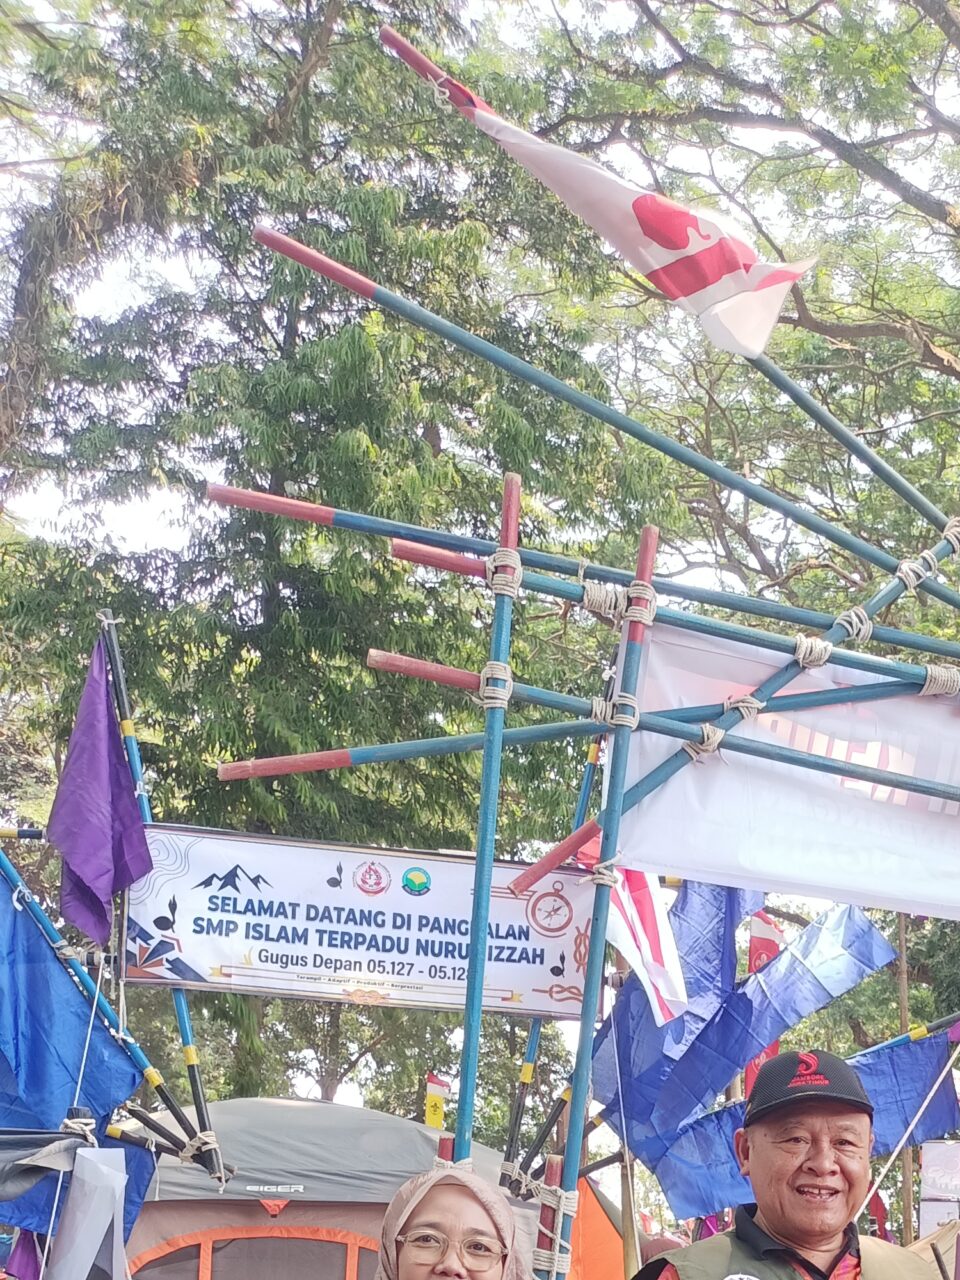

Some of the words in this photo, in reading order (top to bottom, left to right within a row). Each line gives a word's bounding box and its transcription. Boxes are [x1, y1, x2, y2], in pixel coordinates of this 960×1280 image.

[192, 917, 238, 937] SMP
[245, 922, 309, 946] ISLAM
[315, 928, 409, 955] TERPADU
[415, 938, 471, 961] NURU
[488, 945, 545, 965] IZZAH
[207, 895, 300, 920] SELAMAT
[306, 904, 386, 928] DATANG
[392, 913, 411, 931] DI
[418, 917, 530, 942] PANGALAN
[258, 948, 308, 968] Gugus
[313, 953, 362, 973] Depan
[367, 958, 415, 977] 05.127
